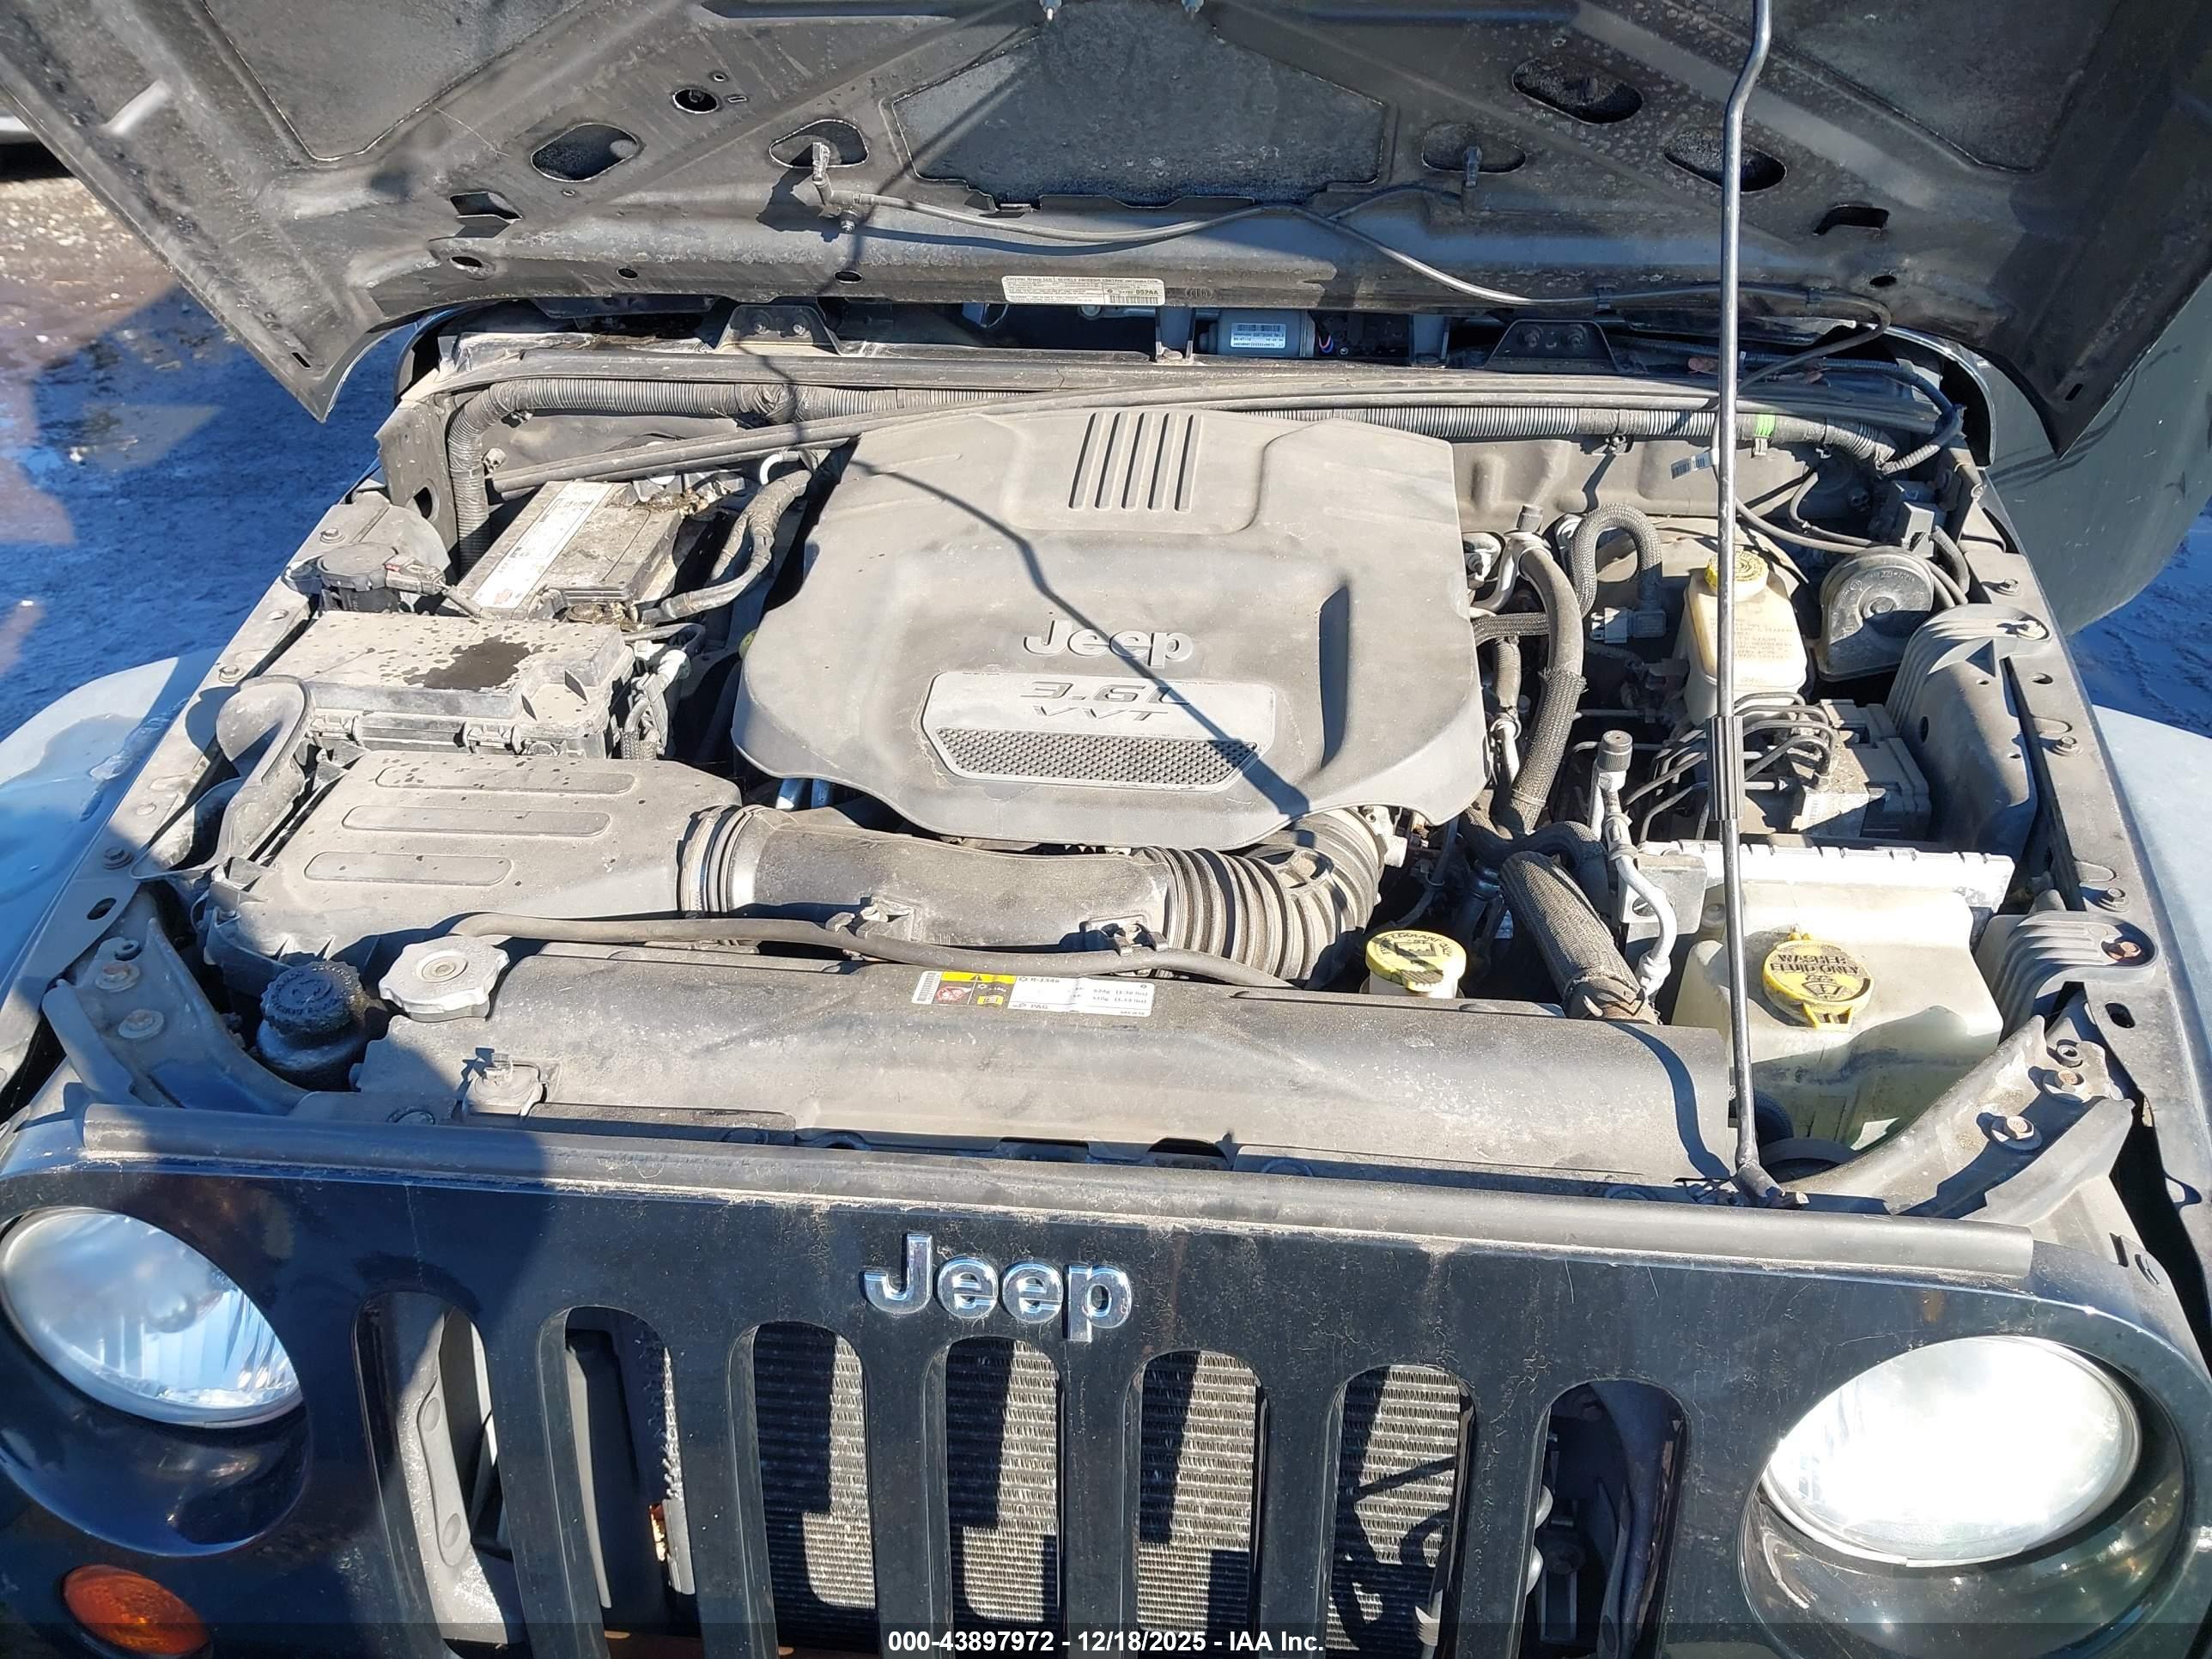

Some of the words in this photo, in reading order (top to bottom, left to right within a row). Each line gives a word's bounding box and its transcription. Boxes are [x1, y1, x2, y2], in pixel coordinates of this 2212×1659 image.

[1024, 620, 1194, 669] Jeep
[1020, 681, 1190, 706] 3.6L
[1033, 705, 1169, 721] VVT
[1770, 963, 1816, 974] FLUID
[1818, 964, 1860, 976] ONLY
[1778, 954, 1848, 965] WASHER
[863, 1233, 1133, 1342] Jeep
